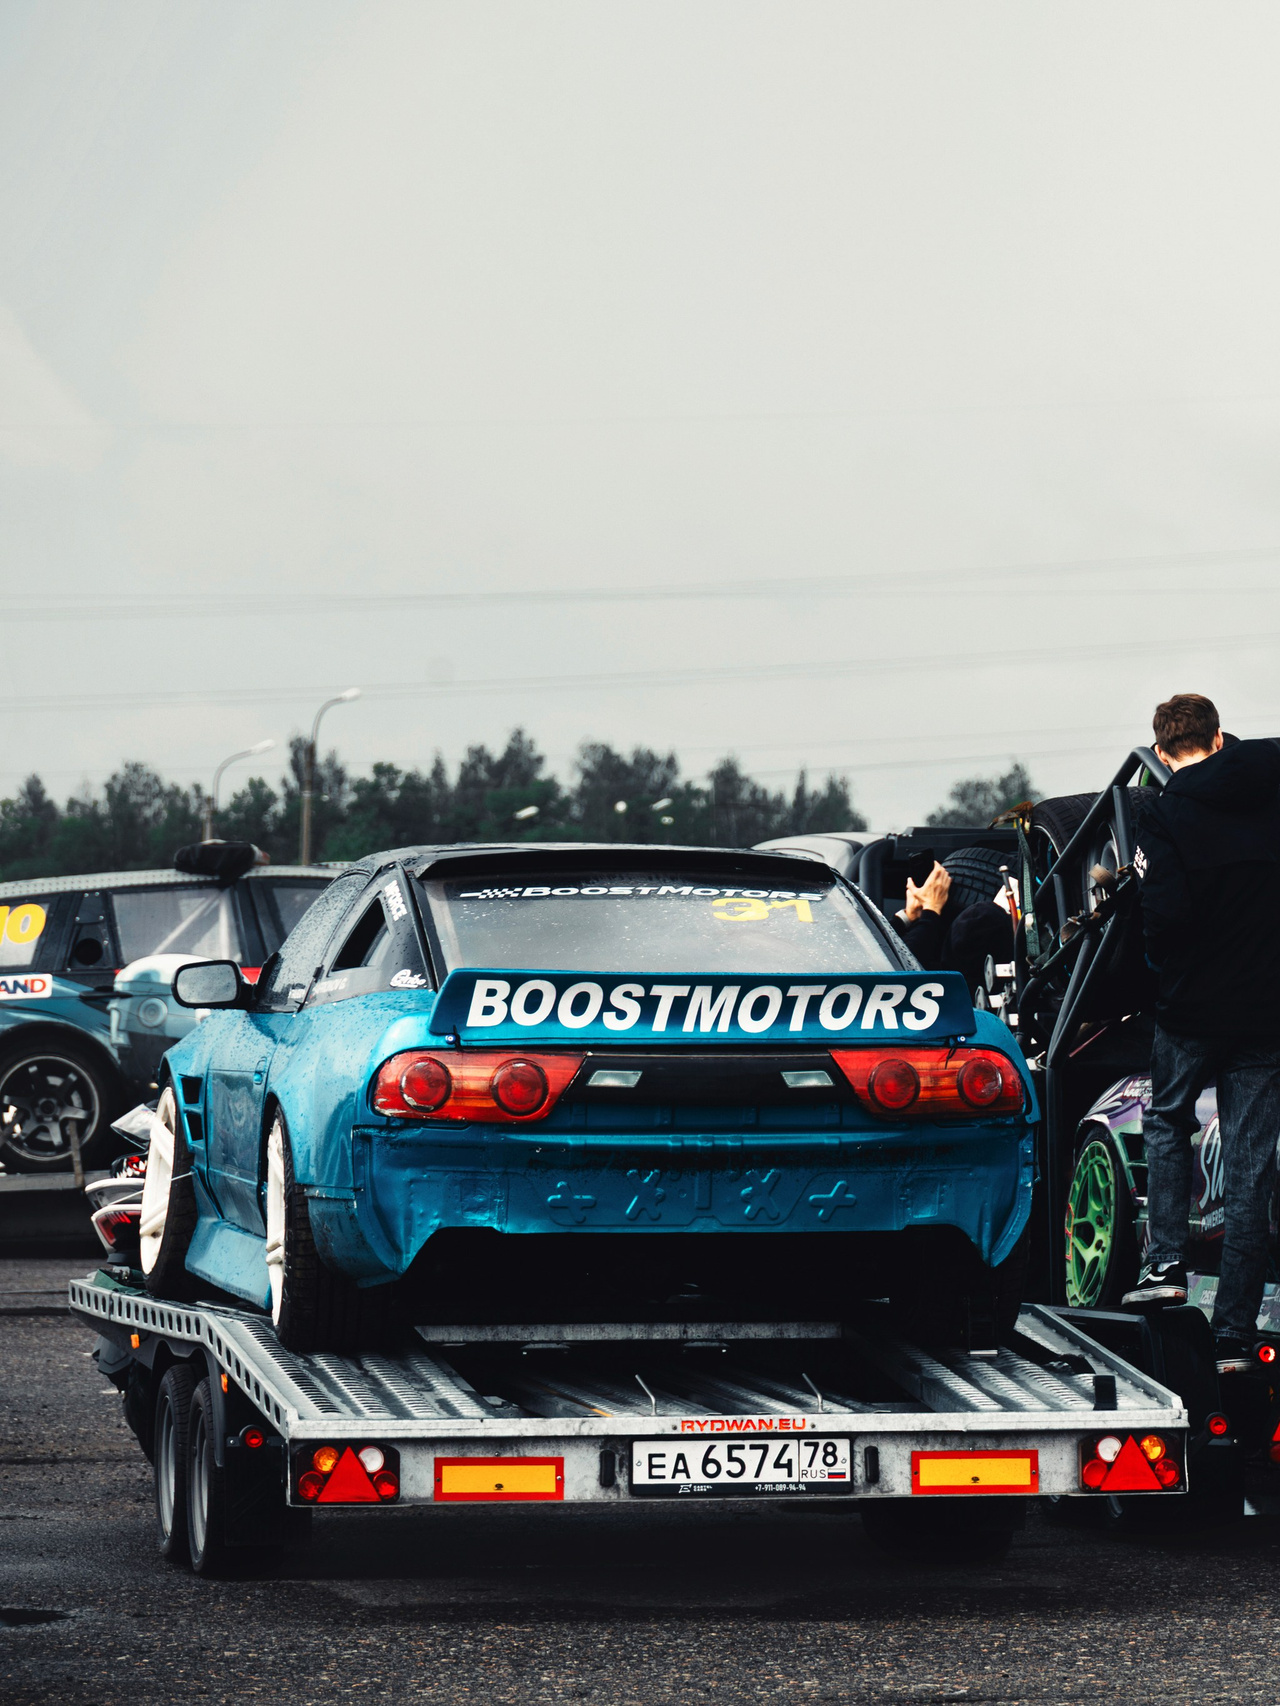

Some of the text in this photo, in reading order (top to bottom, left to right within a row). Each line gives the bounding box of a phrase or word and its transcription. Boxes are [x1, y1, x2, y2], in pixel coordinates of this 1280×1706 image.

[521, 886, 824, 901] BOOSTMOTORS
[466, 978, 945, 1034] BOOSTMOTORS
[680, 1418, 807, 1432] RYDWAN.EU
[701, 1443, 793, 1479] 6574
[803, 1441, 838, 1468] 78
[801, 1469, 826, 1479] RUS
